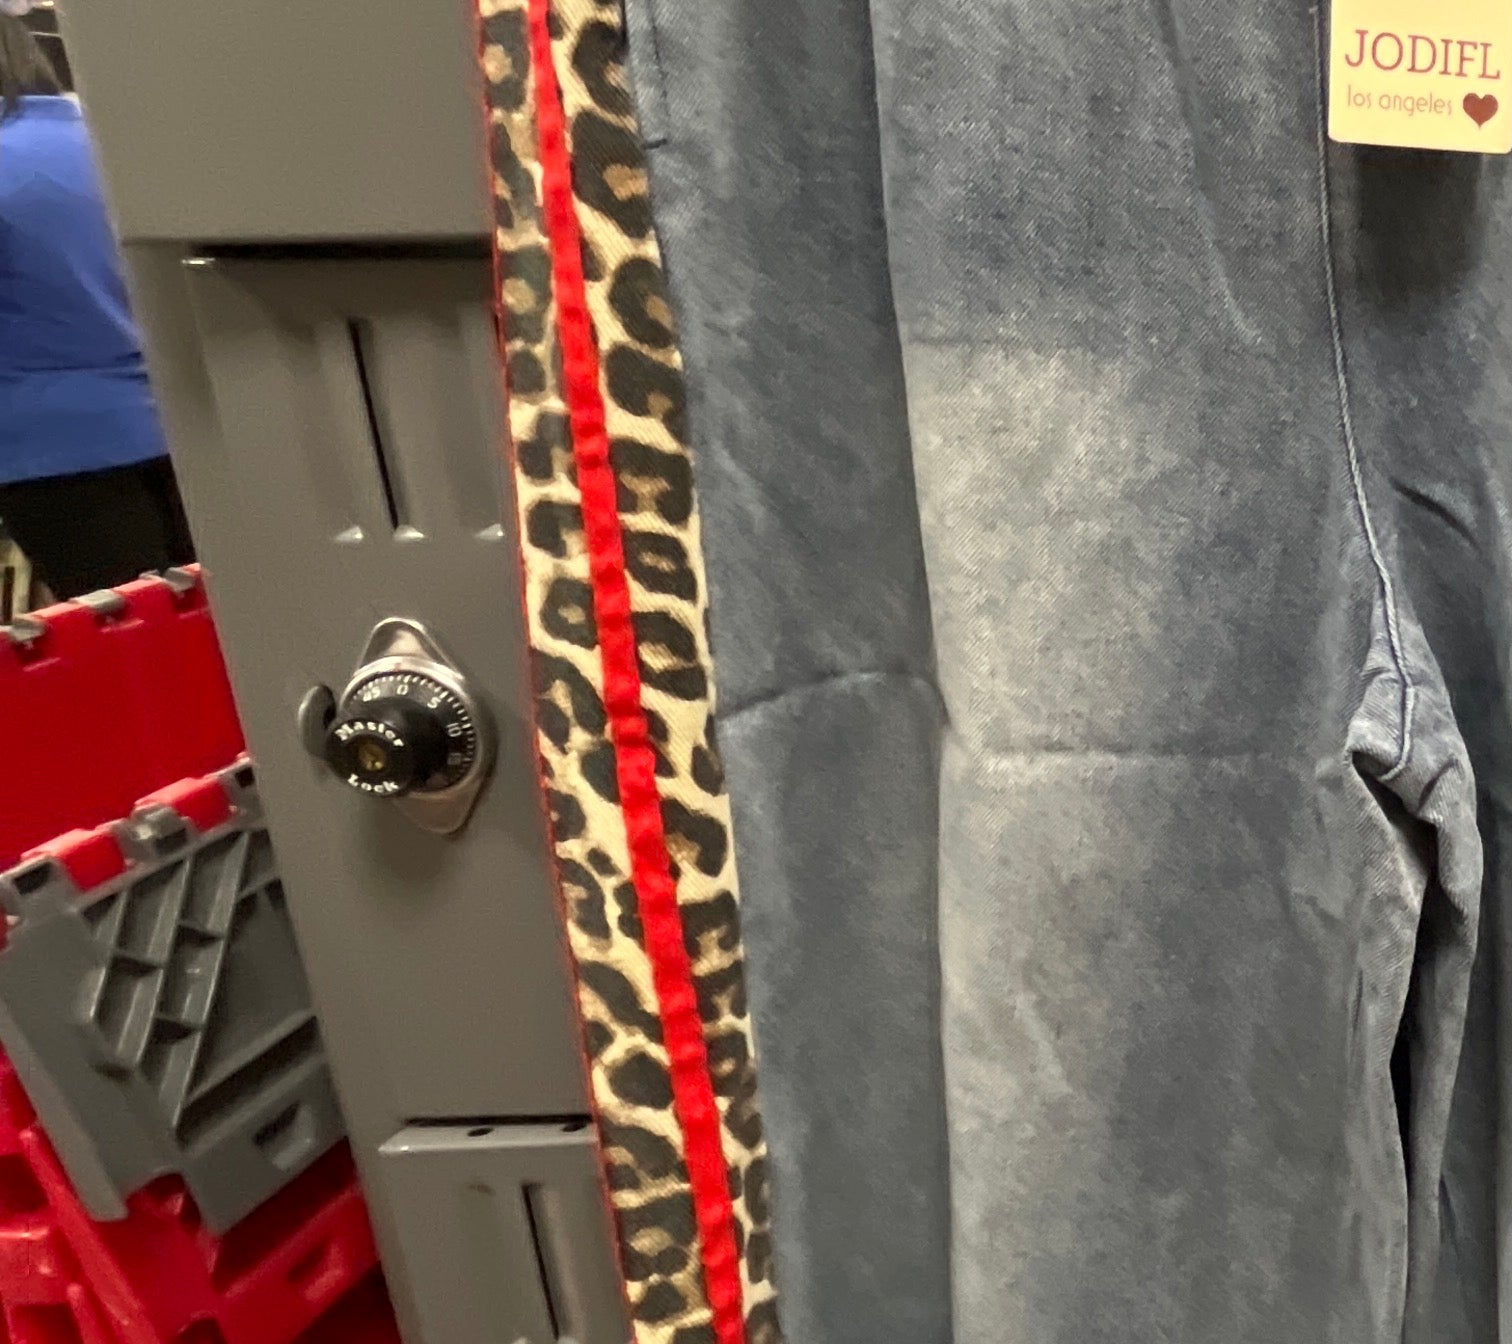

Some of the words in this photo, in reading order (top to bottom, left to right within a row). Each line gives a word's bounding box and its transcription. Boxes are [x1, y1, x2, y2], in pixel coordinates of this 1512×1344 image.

[1345, 29, 1501, 80] JODIFL
[1347, 84, 1372, 110] los
[1378, 92, 1452, 116] angeles
